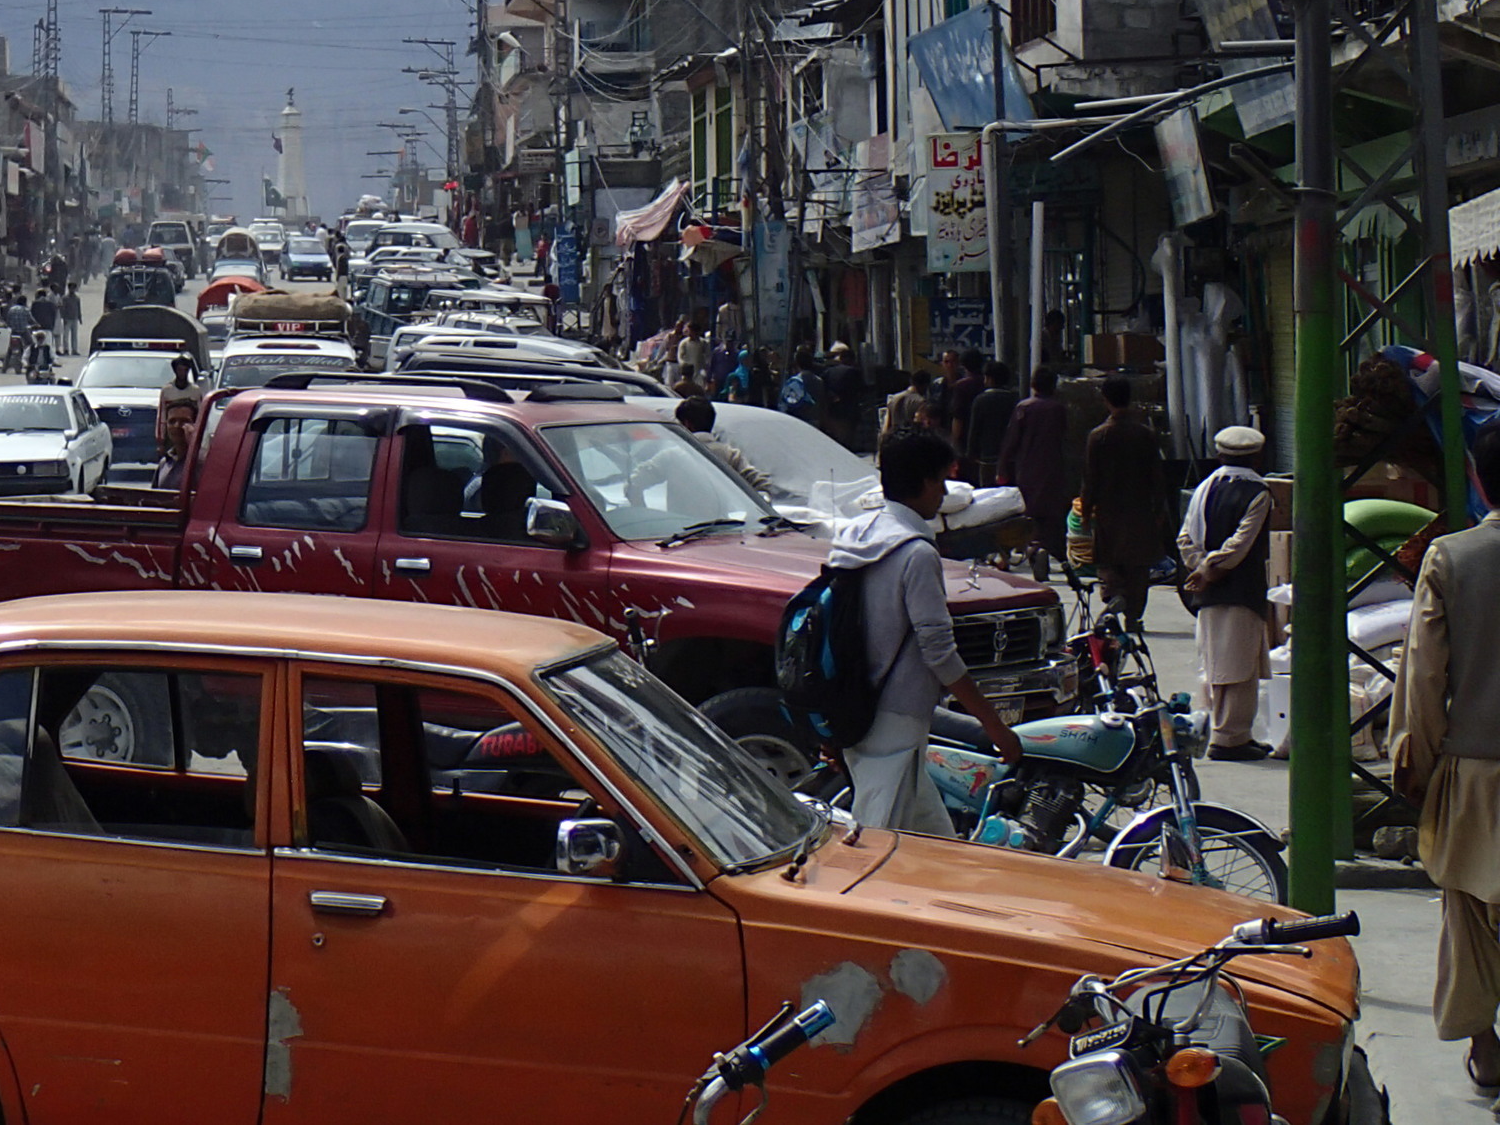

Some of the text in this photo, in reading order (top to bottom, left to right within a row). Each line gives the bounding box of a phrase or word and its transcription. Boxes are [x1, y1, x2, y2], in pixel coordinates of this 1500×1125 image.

[276, 322, 301, 332] VIP
[481, 731, 544, 757] TURAB
[1059, 728, 1100, 745] SHAH
